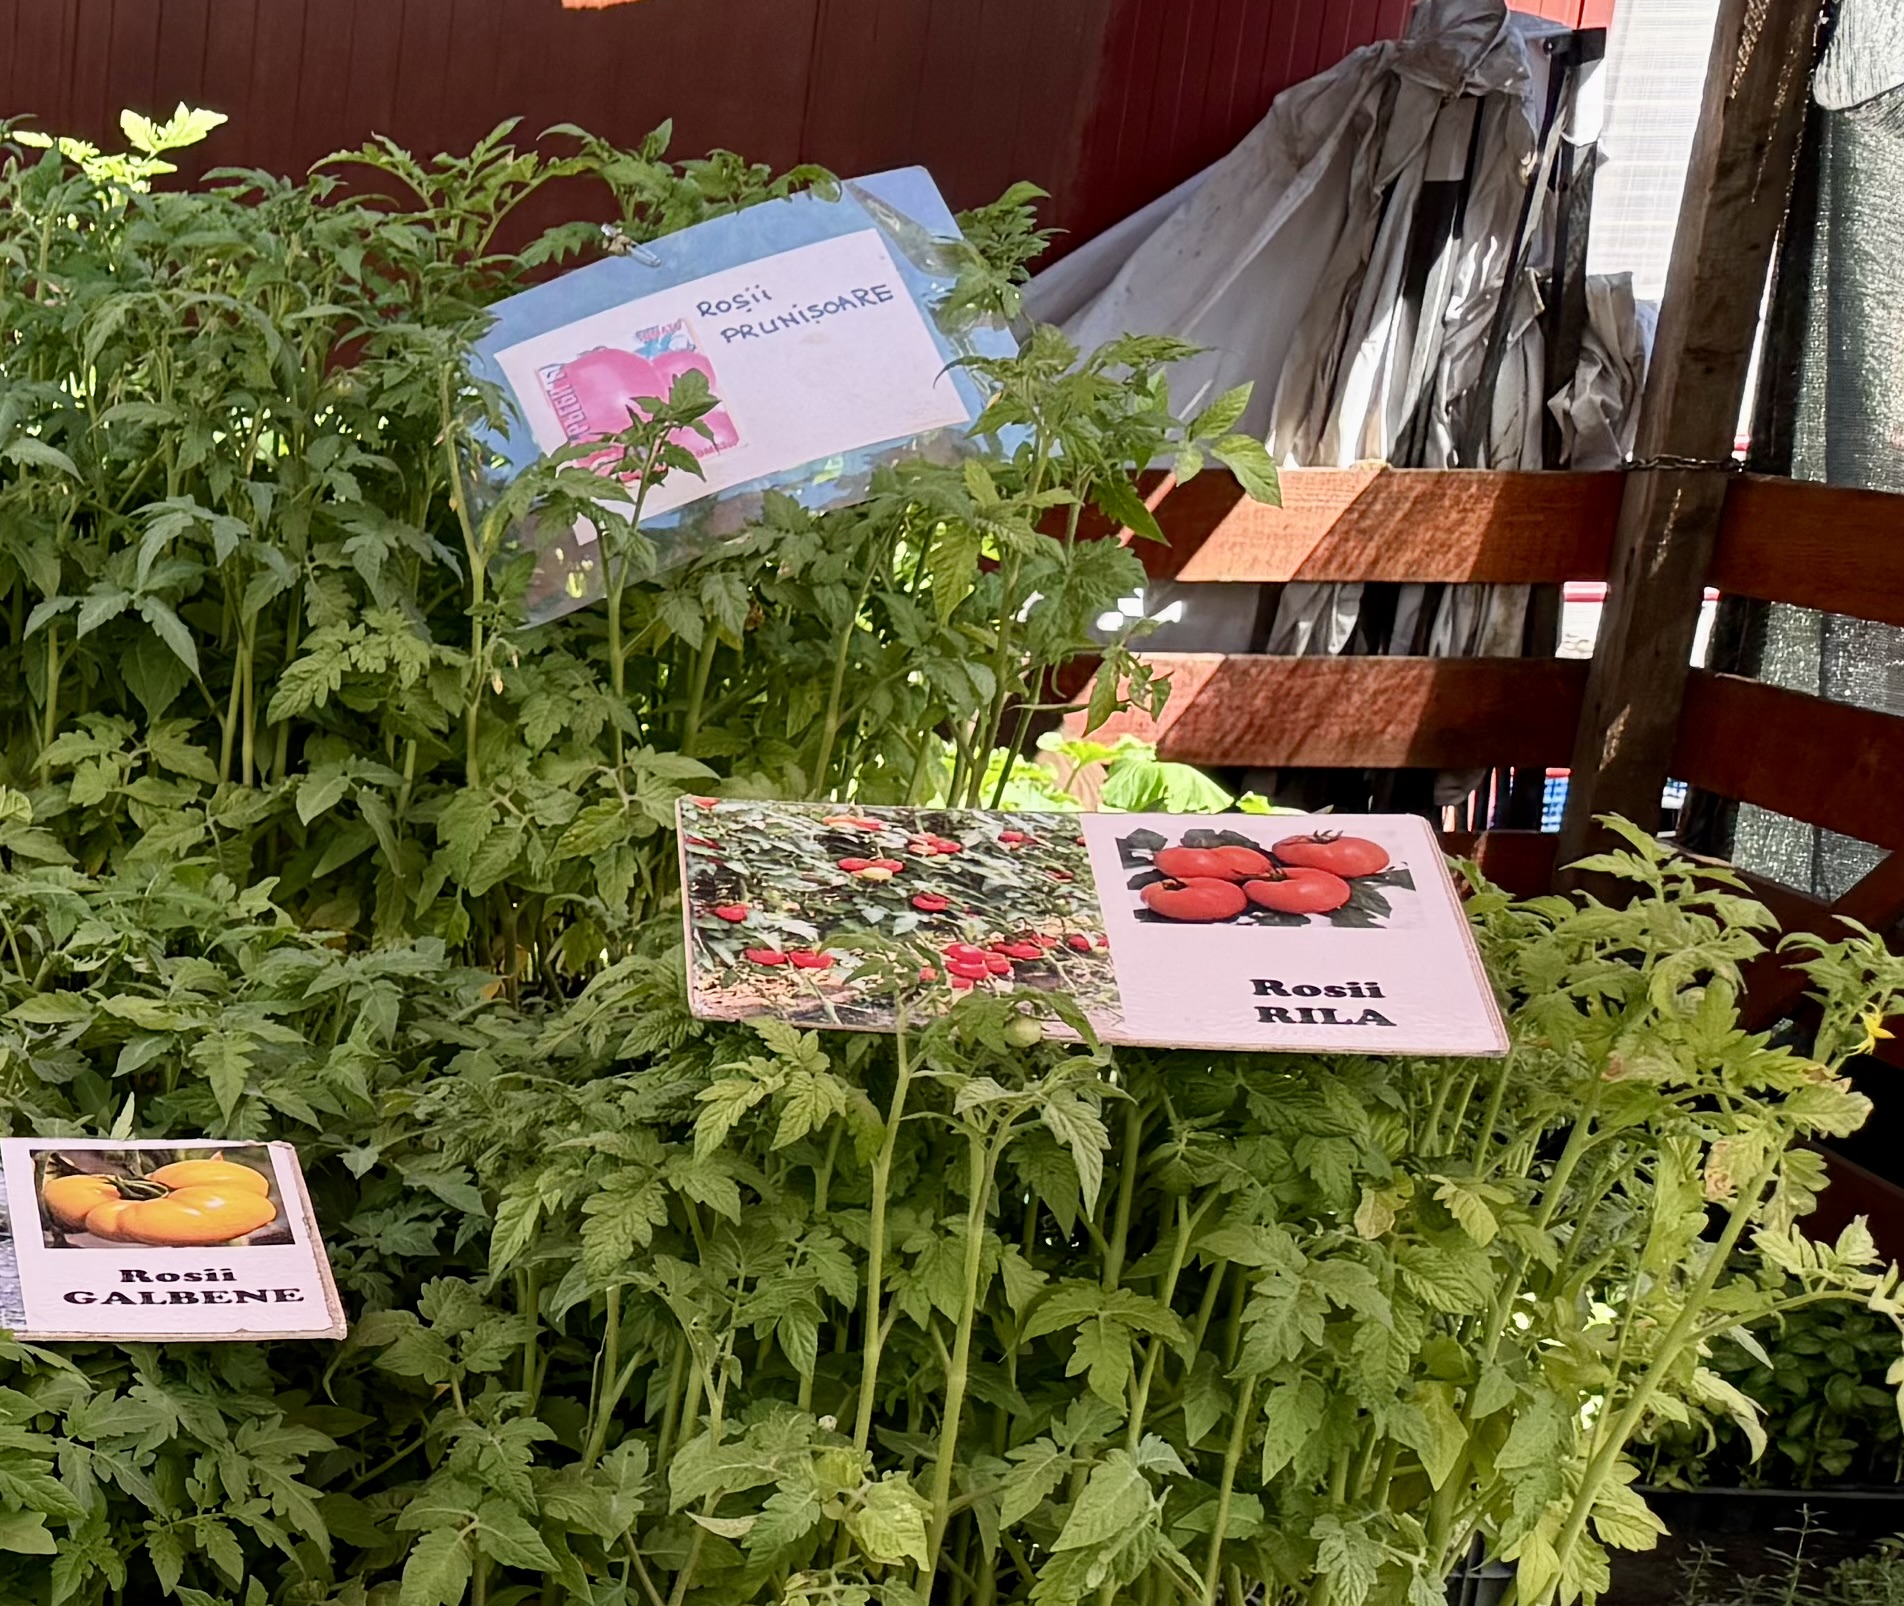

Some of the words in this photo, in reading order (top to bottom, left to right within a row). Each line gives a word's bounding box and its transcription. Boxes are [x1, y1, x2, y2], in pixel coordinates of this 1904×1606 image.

[1249, 979, 1386, 998] Rosii
[1254, 1006, 1398, 1027] RILA
[119, 1268, 237, 1283] Rosii
[63, 1288, 304, 1305] GALBENE
